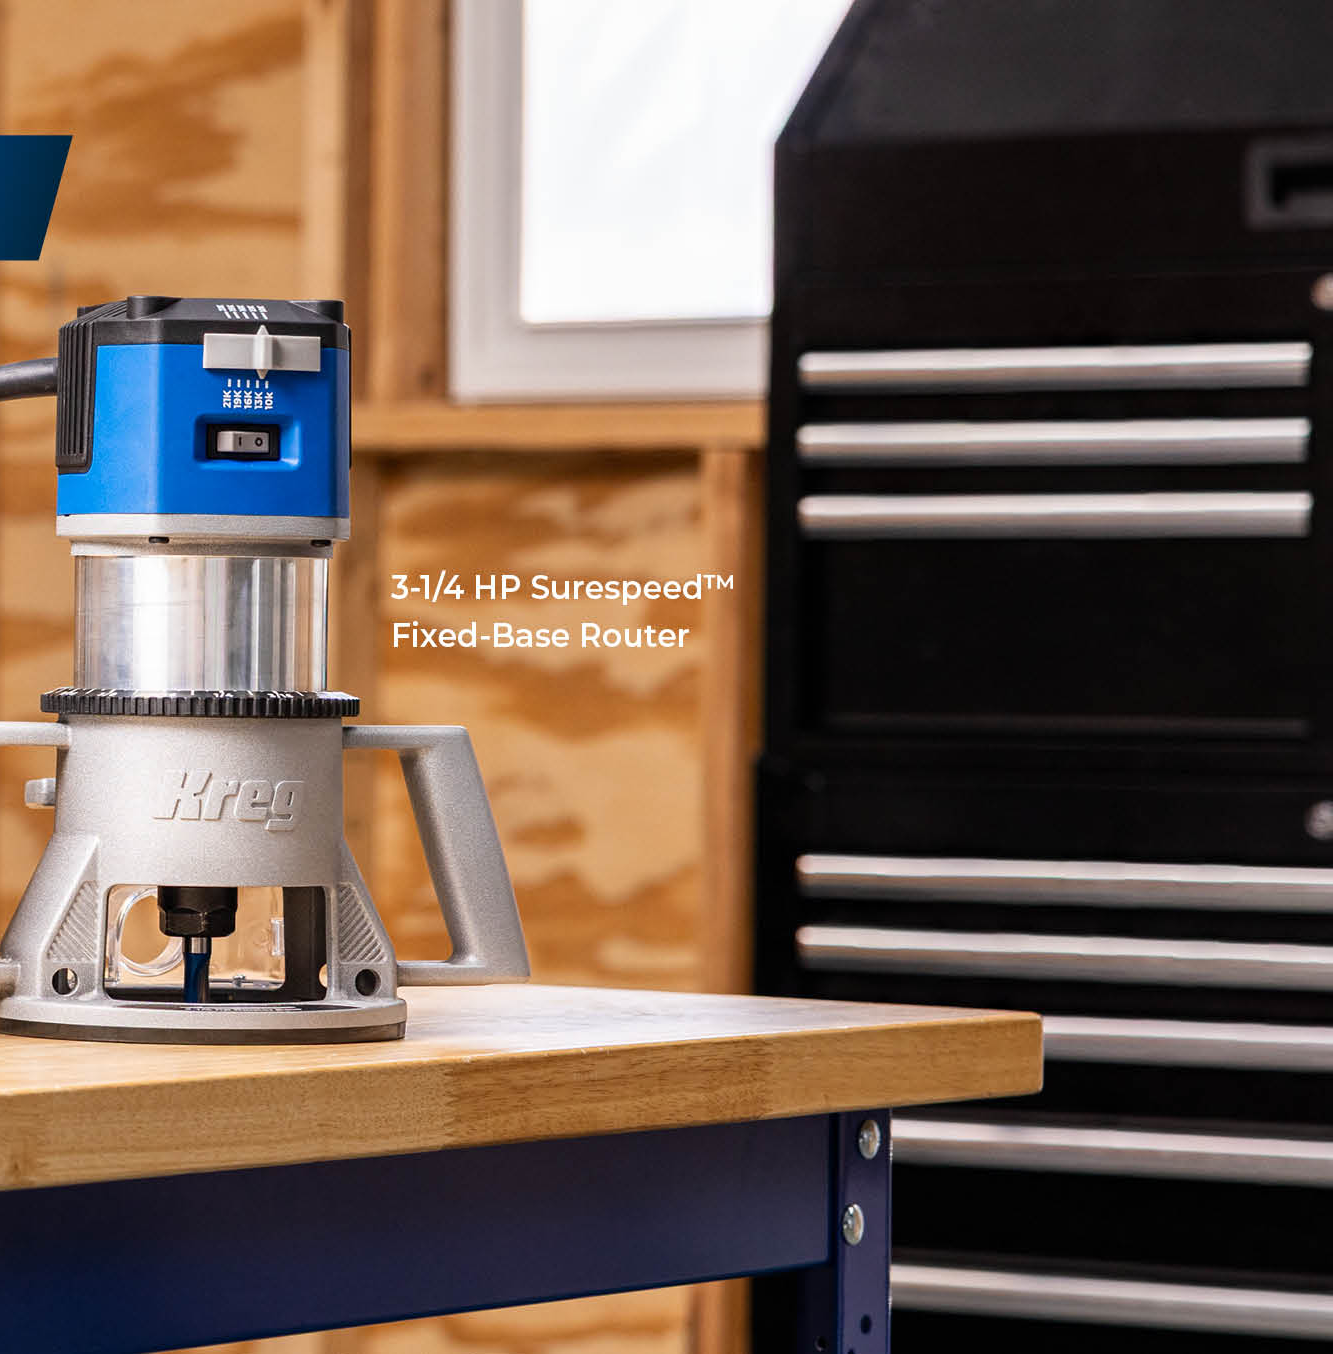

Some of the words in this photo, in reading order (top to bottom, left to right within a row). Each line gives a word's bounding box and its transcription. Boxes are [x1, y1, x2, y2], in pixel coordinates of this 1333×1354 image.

[222, 390, 232, 409] 21K
[233, 390, 242, 409] 19K
[243, 390, 253, 409] 16K
[254, 391, 263, 410] 13K
[264, 391, 274, 411] 10K
[152, 769, 305, 831] Kreg
